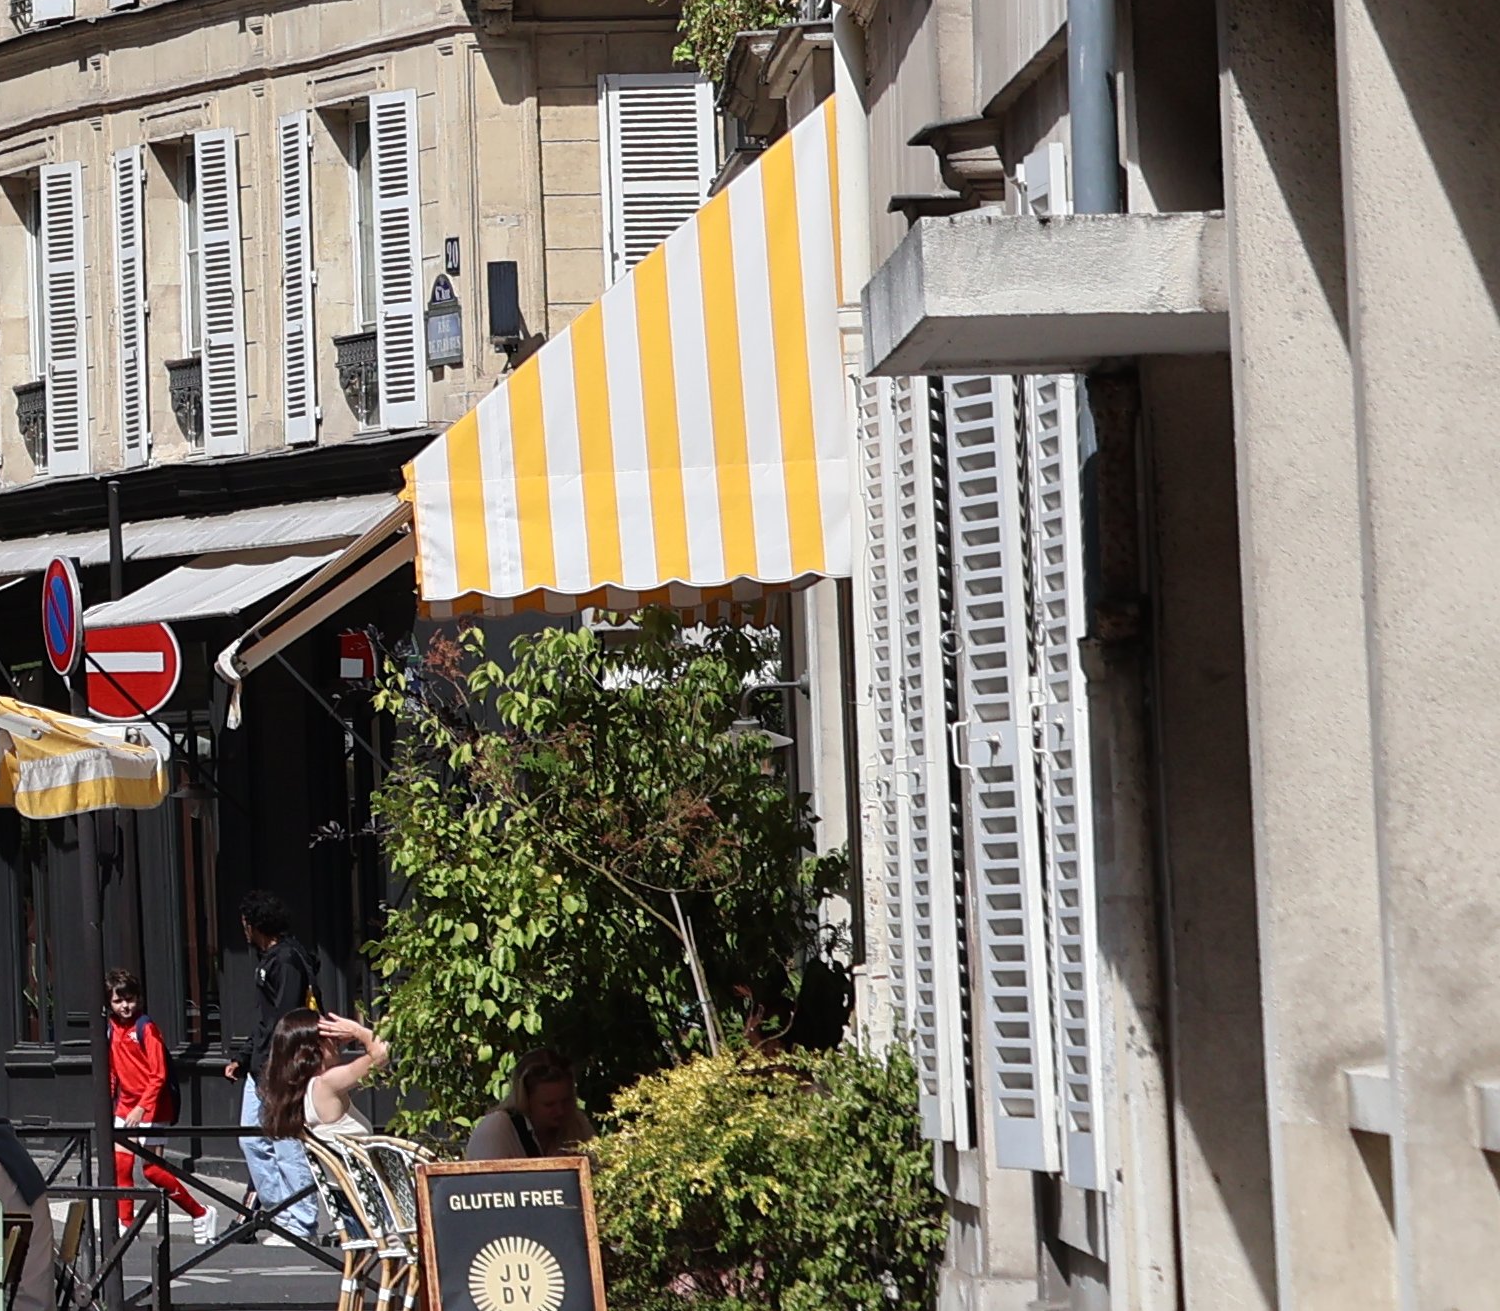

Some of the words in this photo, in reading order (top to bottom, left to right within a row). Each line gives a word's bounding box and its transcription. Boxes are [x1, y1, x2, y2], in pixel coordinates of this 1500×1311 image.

[446, 240, 459, 269] 20
[449, 1191, 515, 1211] GLUTEN
[520, 1189, 565, 1208] FREE
[500, 1263, 531, 1283] JU
[502, 1285, 532, 1305] DY
